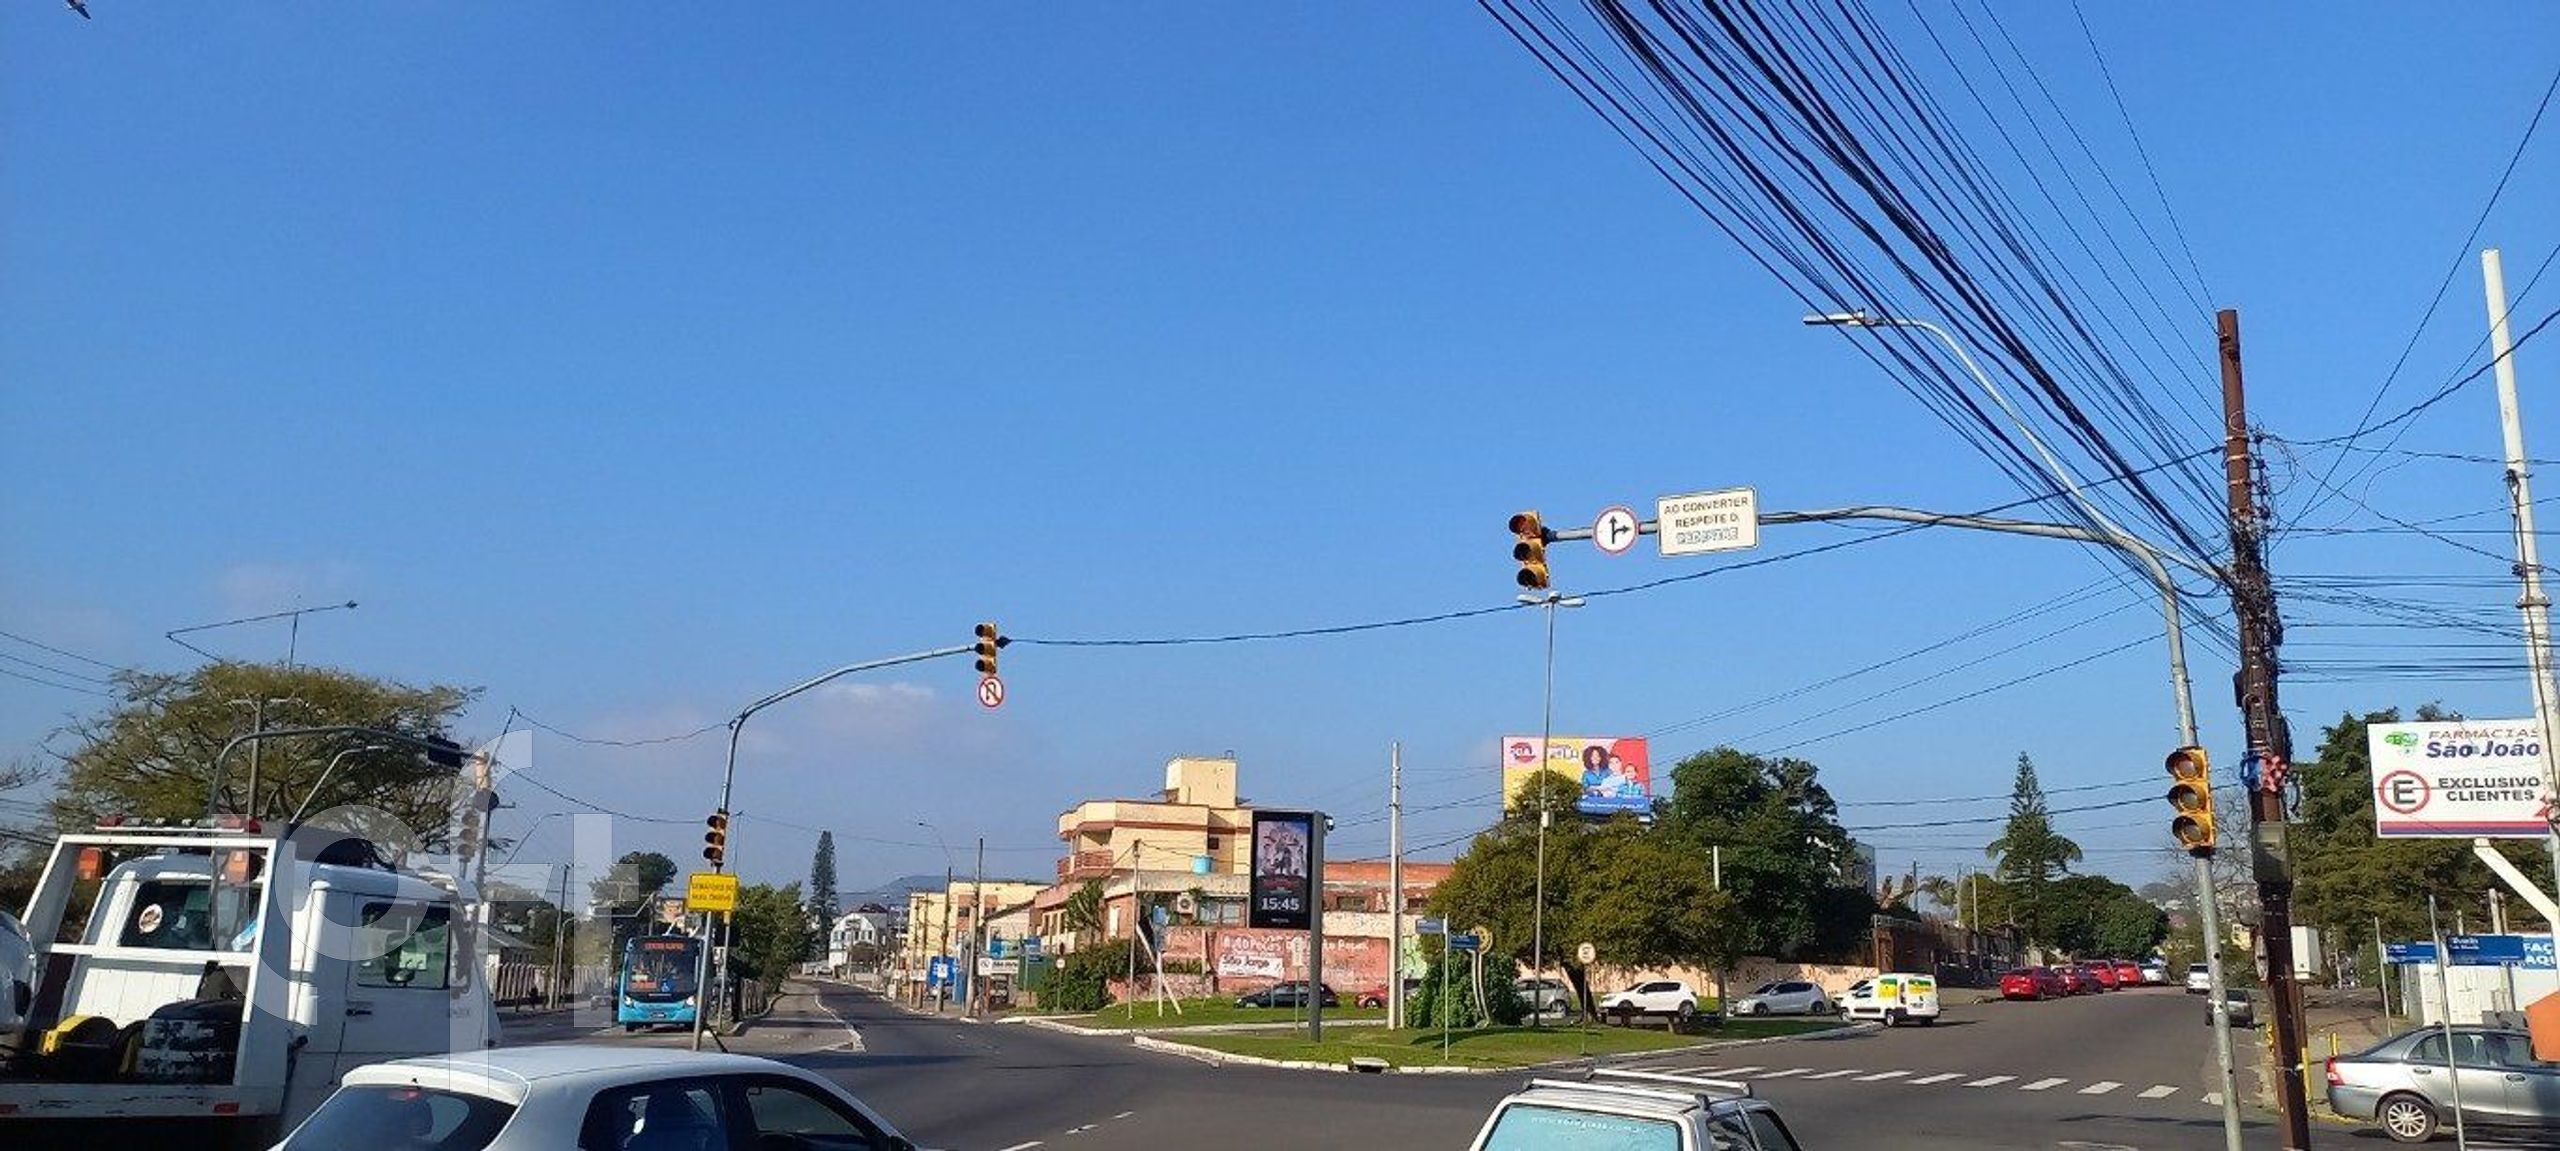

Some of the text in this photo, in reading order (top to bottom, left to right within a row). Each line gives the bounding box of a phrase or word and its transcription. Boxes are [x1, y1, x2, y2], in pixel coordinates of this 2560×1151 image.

[2426, 738, 2540, 758] São João
[2438, 776, 2541, 789] EXCLUSIVO
[2446, 790, 2535, 801] CLIENTES
[1262, 898, 1300, 910] 15:45
